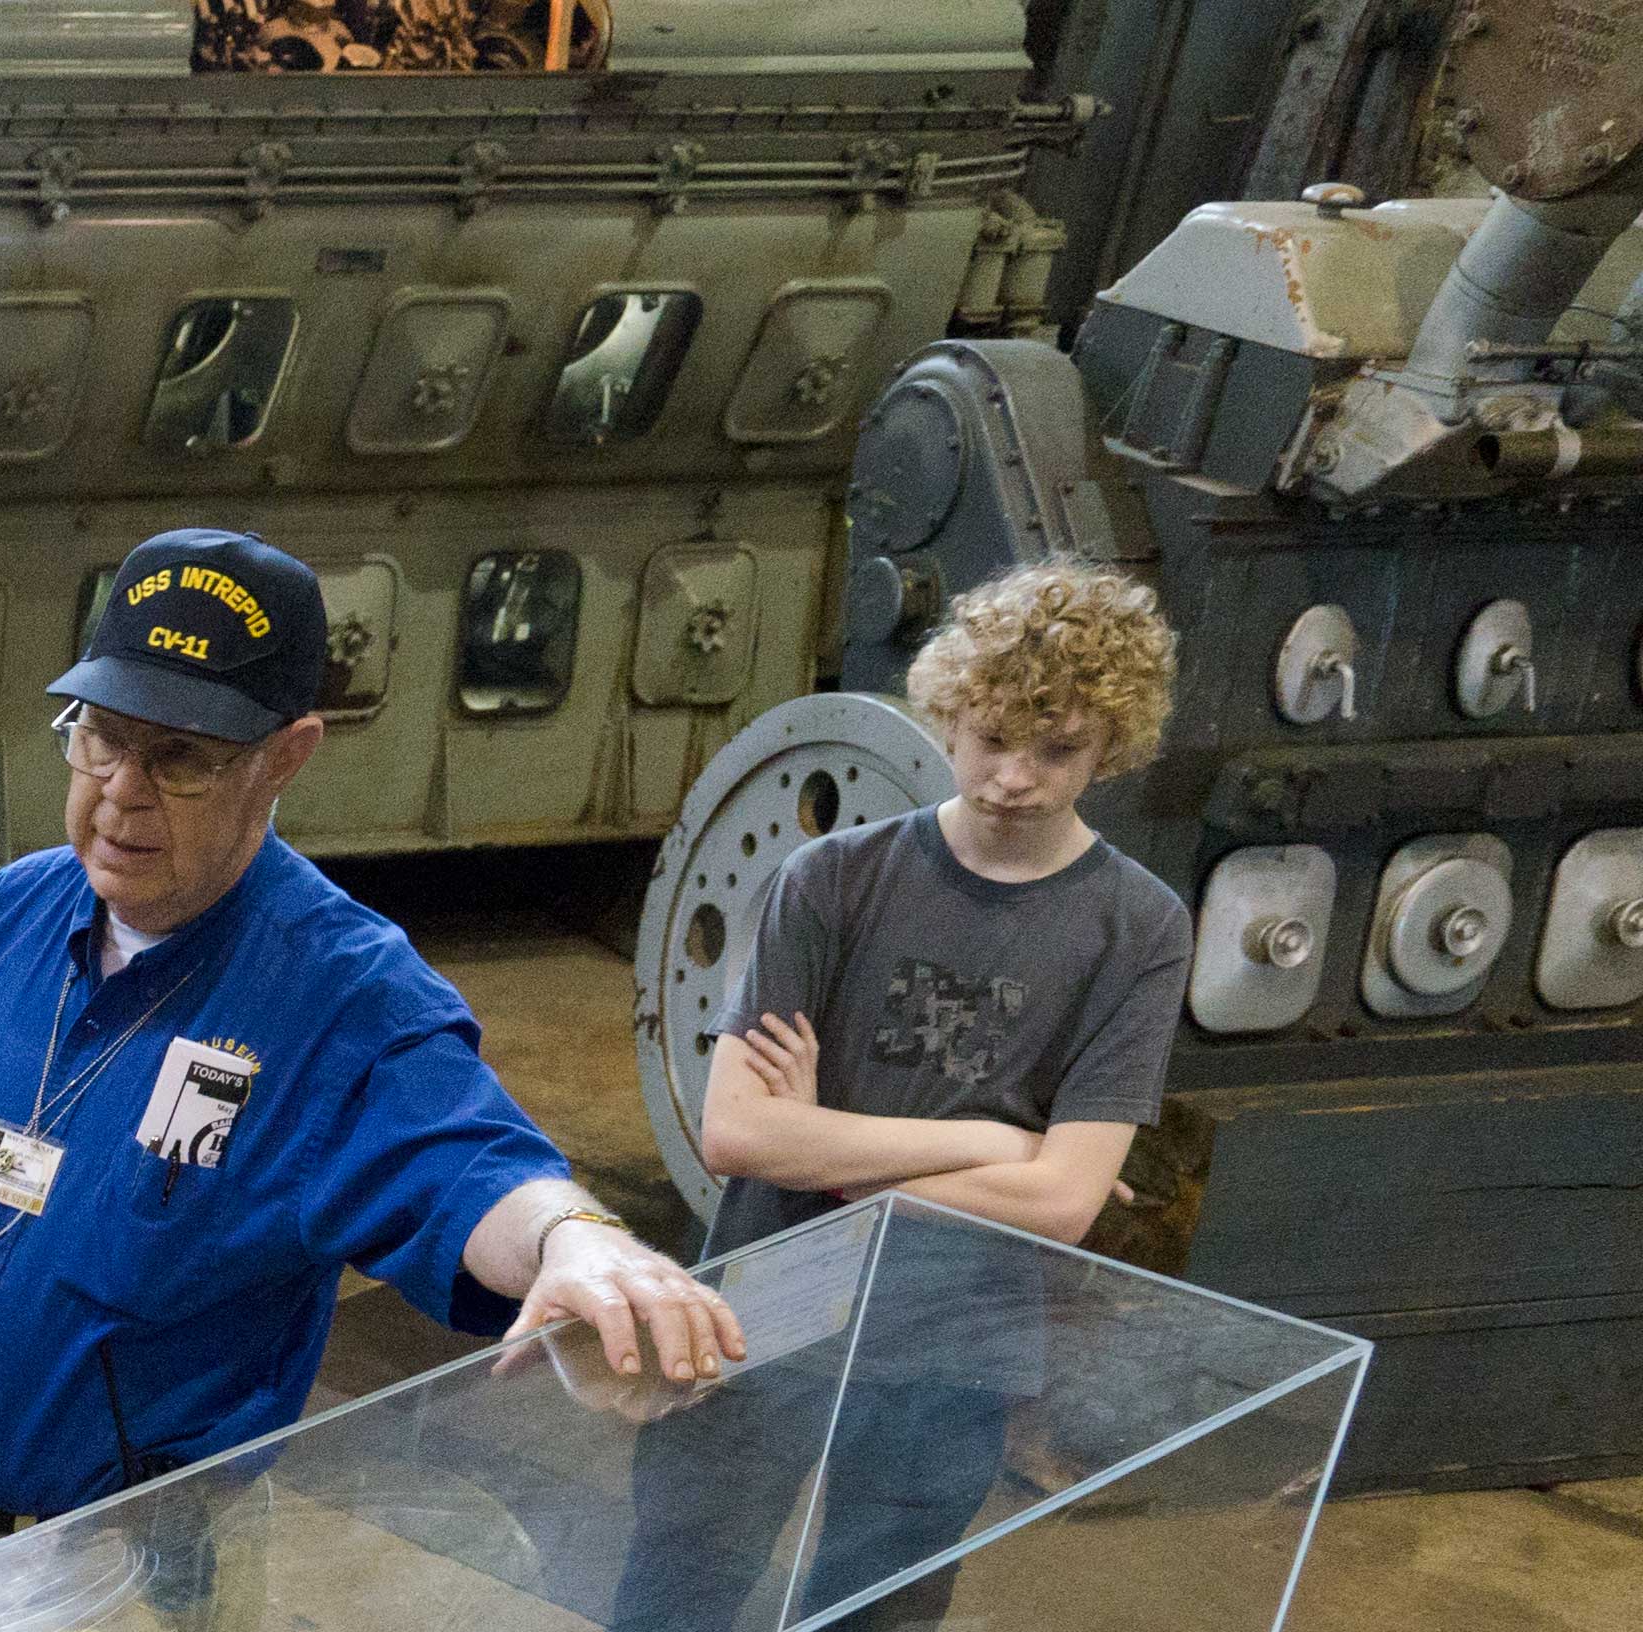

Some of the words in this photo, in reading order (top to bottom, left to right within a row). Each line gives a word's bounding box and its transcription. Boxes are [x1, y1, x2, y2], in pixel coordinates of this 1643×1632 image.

[127, 569, 172, 606] USS
[180, 566, 271, 638] INTREPID
[147, 626, 210, 660] CV-11
[200, 1037, 262, 1075] USEUM
[192, 1064, 244, 1088] TODAY'S
